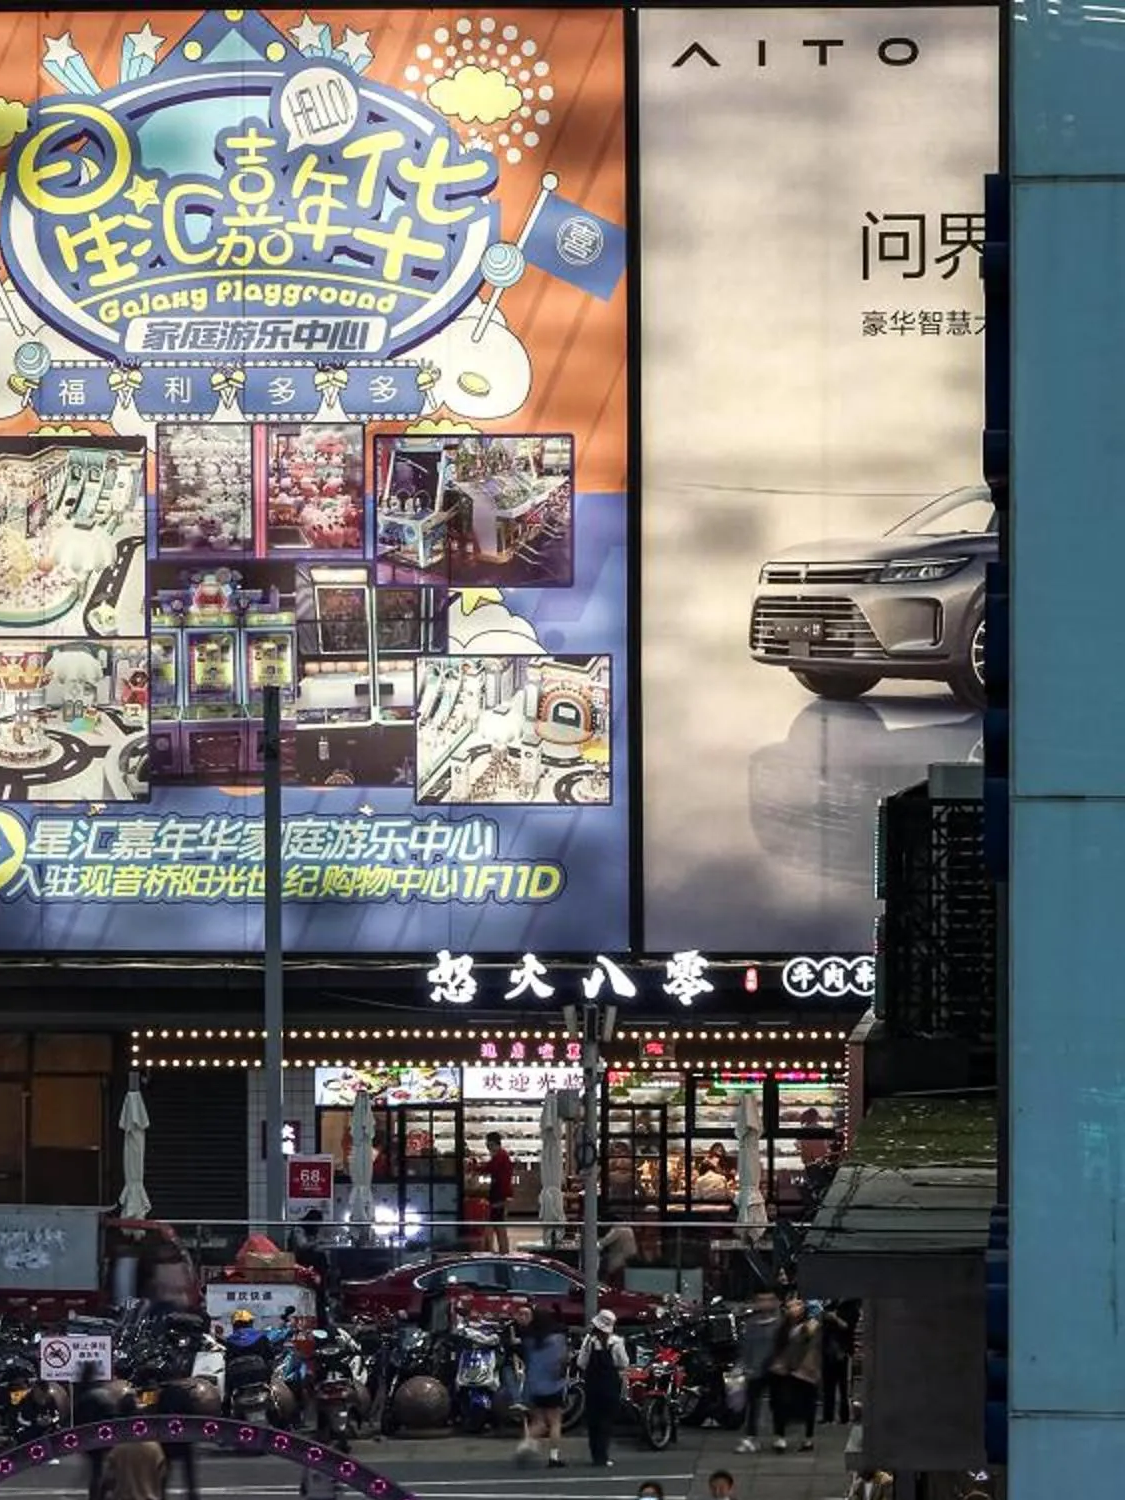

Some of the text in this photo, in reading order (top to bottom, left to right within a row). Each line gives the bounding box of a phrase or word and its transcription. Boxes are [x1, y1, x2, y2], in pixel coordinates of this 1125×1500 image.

[671, 37, 920, 67] AITO
[861, 210, 986, 281] 问界
[98, 280, 397, 323] Galaxy Playground
[142, 319, 369, 350] 家庭游乐中心
[26, 817, 494, 863] 星汇嘉年华家庭游乐中心
